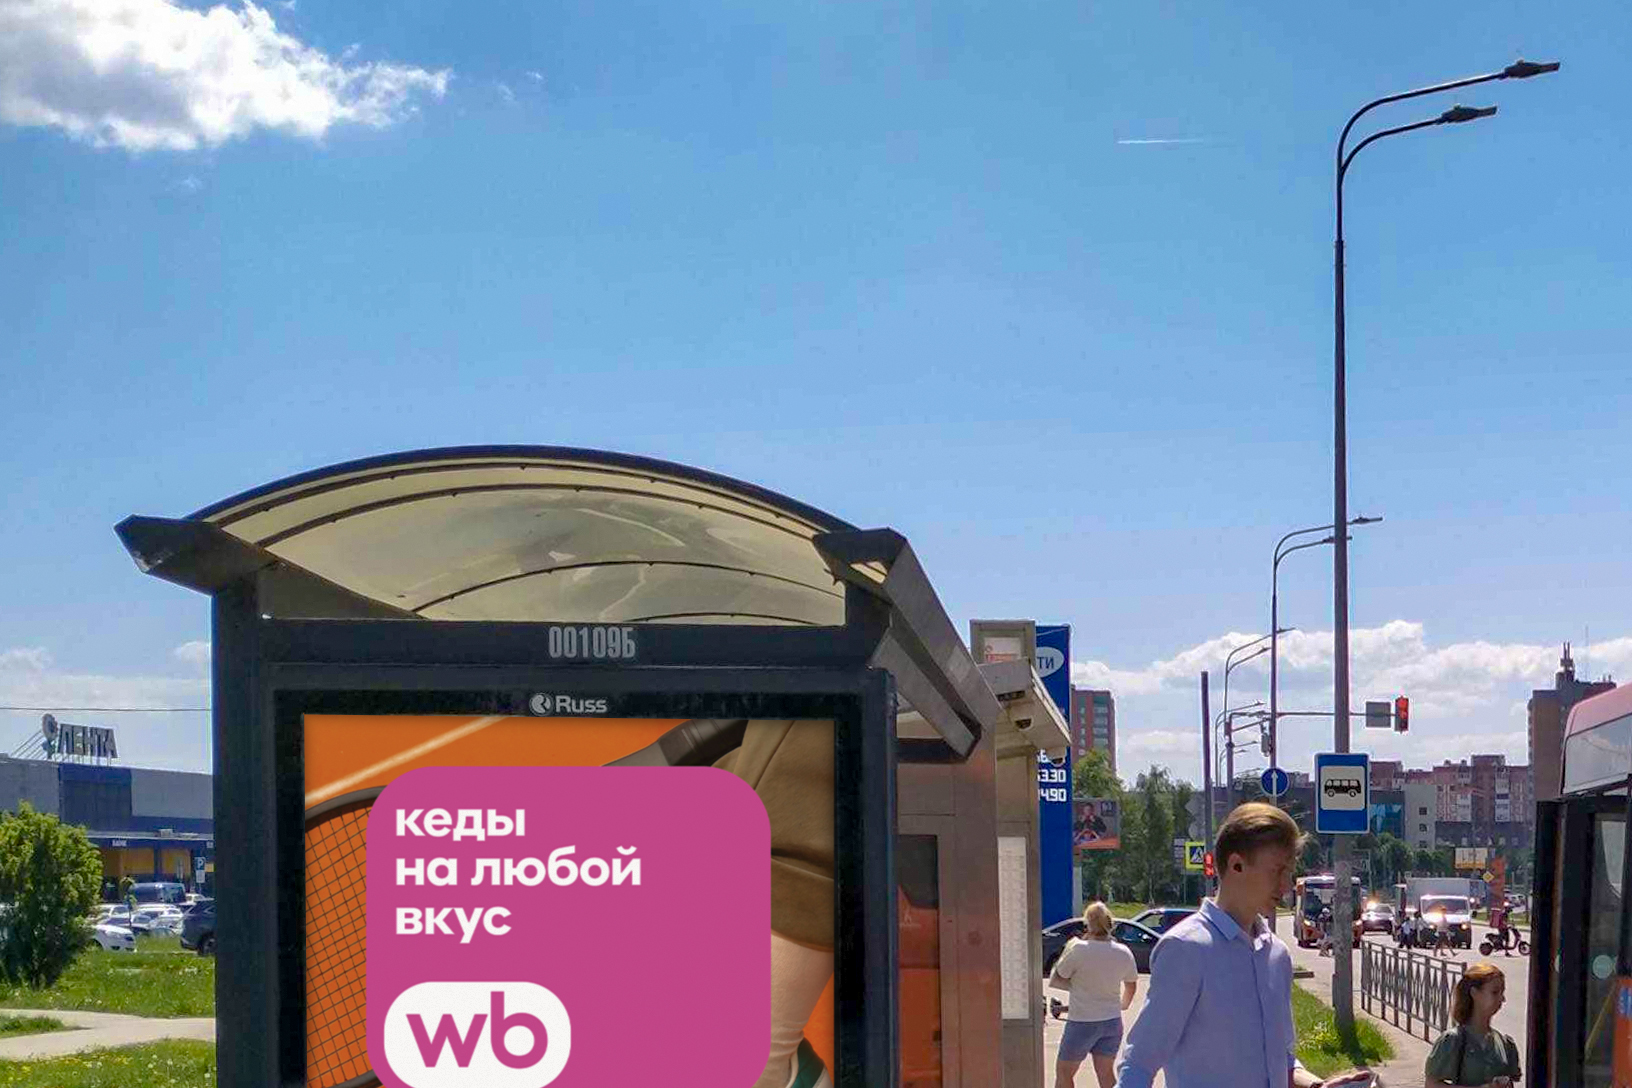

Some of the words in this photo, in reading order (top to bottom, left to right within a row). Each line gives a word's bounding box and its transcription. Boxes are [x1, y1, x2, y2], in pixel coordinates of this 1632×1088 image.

[555, 695, 608, 713] Russ
[58, 724, 118, 758] ЛЕНТА
[396, 808, 525, 841] кеды
[396, 857, 457, 886] на
[471, 845, 641, 886] любой
[396, 906, 512, 944] вкус
[406, 991, 548, 1069] wb
